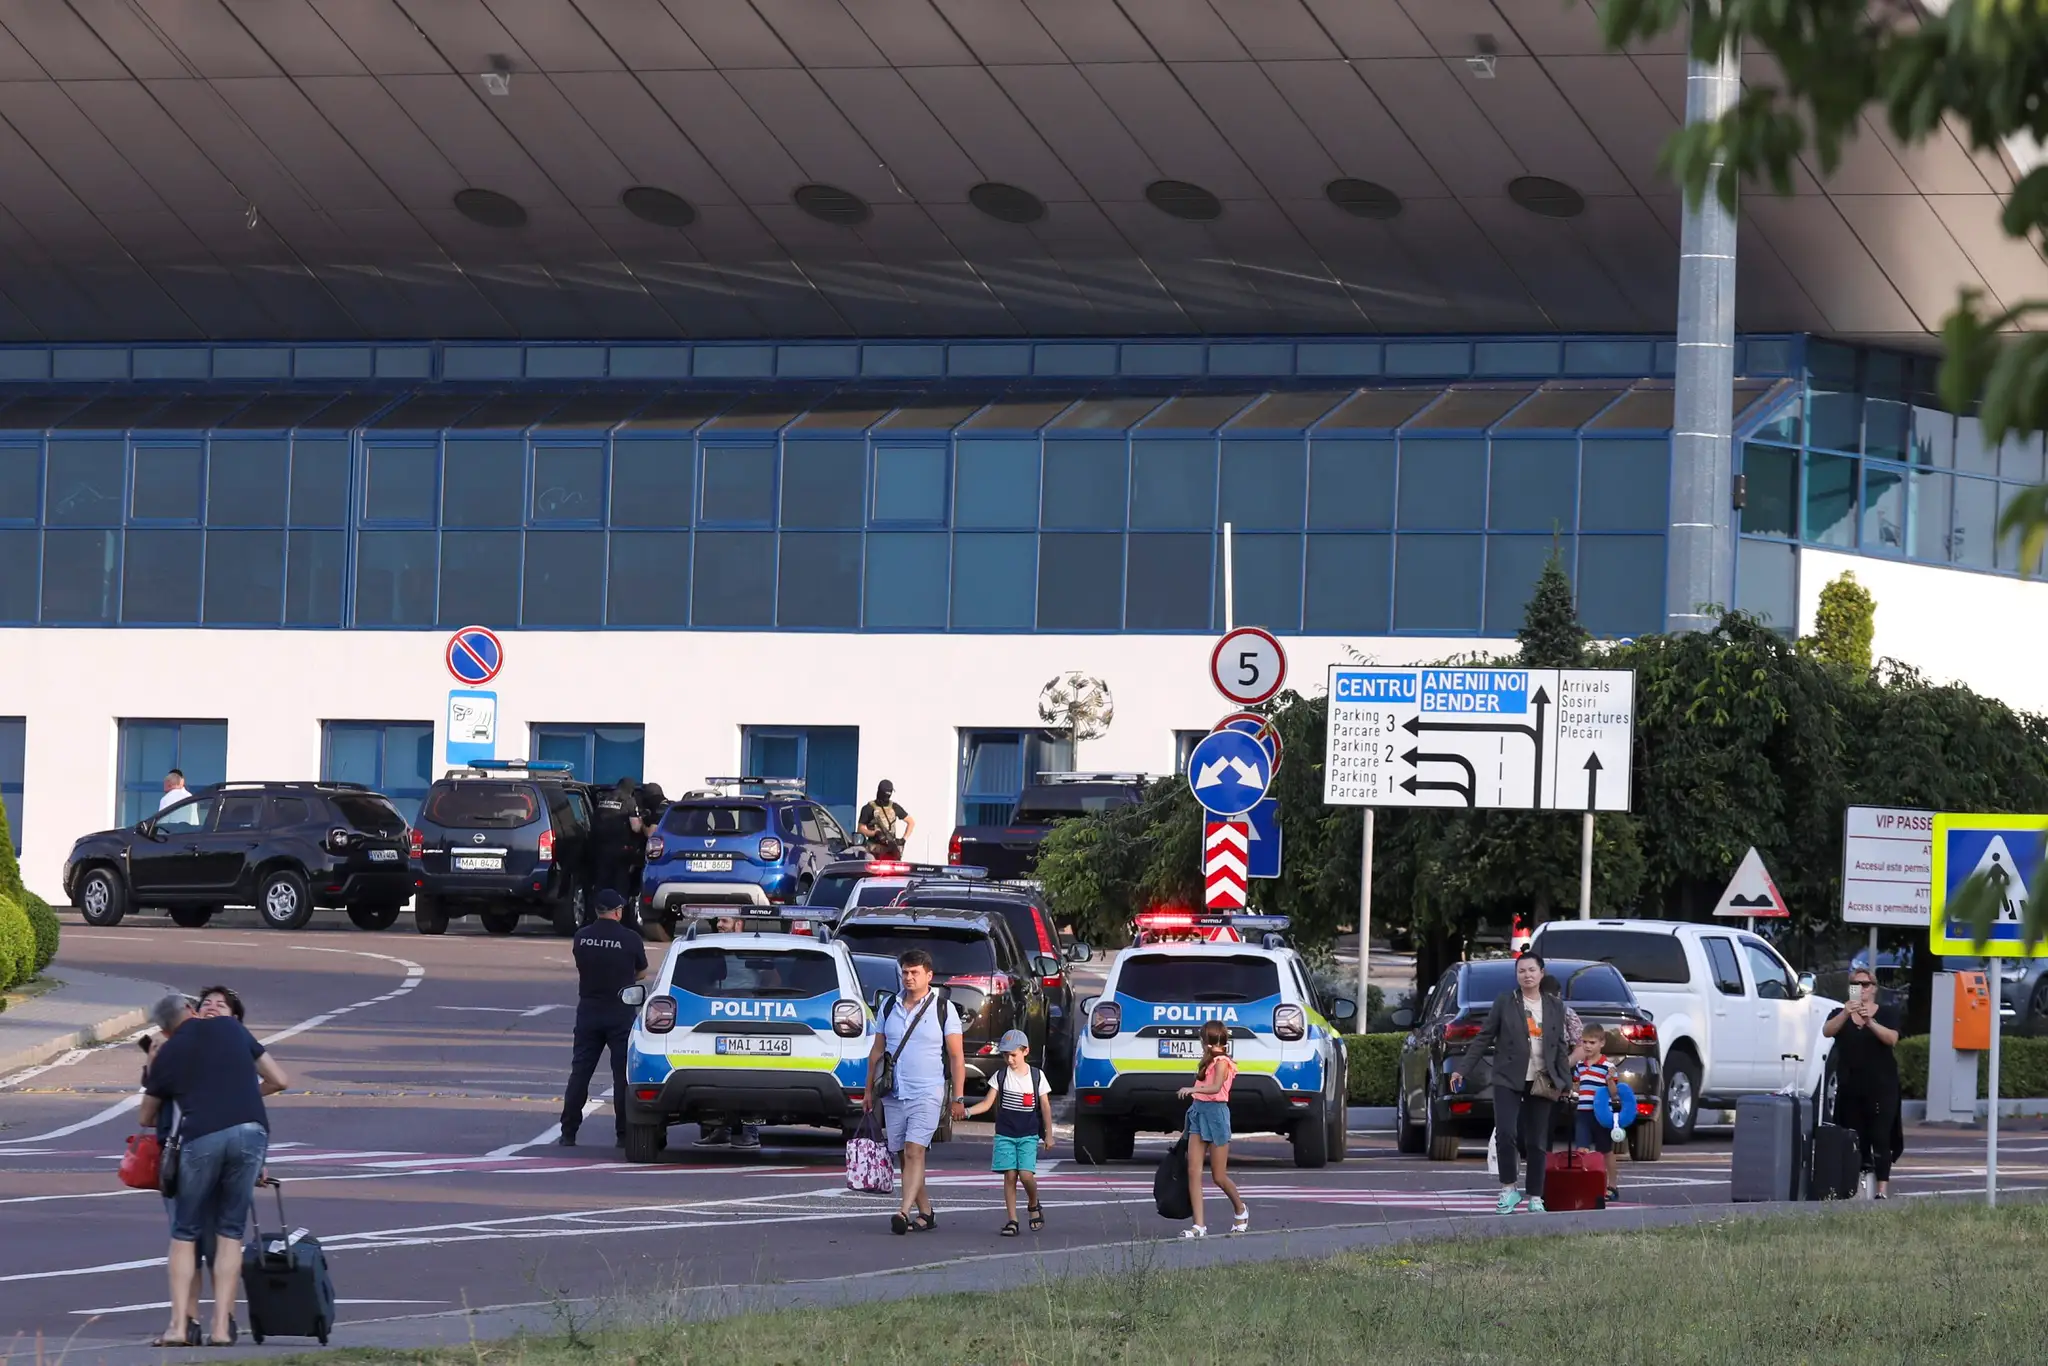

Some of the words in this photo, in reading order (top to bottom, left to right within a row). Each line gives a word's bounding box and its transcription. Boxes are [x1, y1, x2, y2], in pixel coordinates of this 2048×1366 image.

[1238, 652, 1259, 686] 5
[1337, 678, 1415, 697] CENTRU
[1424, 672, 1490, 690] ANENII
[1494, 674, 1526, 691] NOI
[1562, 679, 1610, 693] Arrivals
[1423, 693, 1500, 711] BENDER
[1561, 695, 1596, 708] Sosiri
[1334, 708, 1380, 724] Parking
[1386, 714, 1395, 732] 3
[1561, 710, 1629, 726] Departures
[1333, 723, 1380, 737] Parcare
[1333, 738, 1378, 755] Parking
[1385, 744, 1394, 763] 2
[1332, 754, 1379, 767] Parcare
[1331, 769, 1377, 786] Parking
[1389, 775, 1393, 793] 1
[1331, 785, 1378, 798] Parcare
[1876, 814, 1895, 829] VIP
[1897, 816, 1932, 831] PASSE
[693, 861, 707, 869] MAI
[1855, 860, 1885, 872] Accesul
[1886, 862, 1902, 872] este
[1904, 863, 1930, 874] permis
[1847, 901, 1873, 912] Access
[1875, 903, 1882, 912] is
[1883, 904, 1918, 914] permitted
[1919, 904, 1928, 914] to
[728, 1039, 751, 1051] MAI
[758, 1040, 789, 1052] 1148
[1171, 1042, 1193, 1053] MAI
